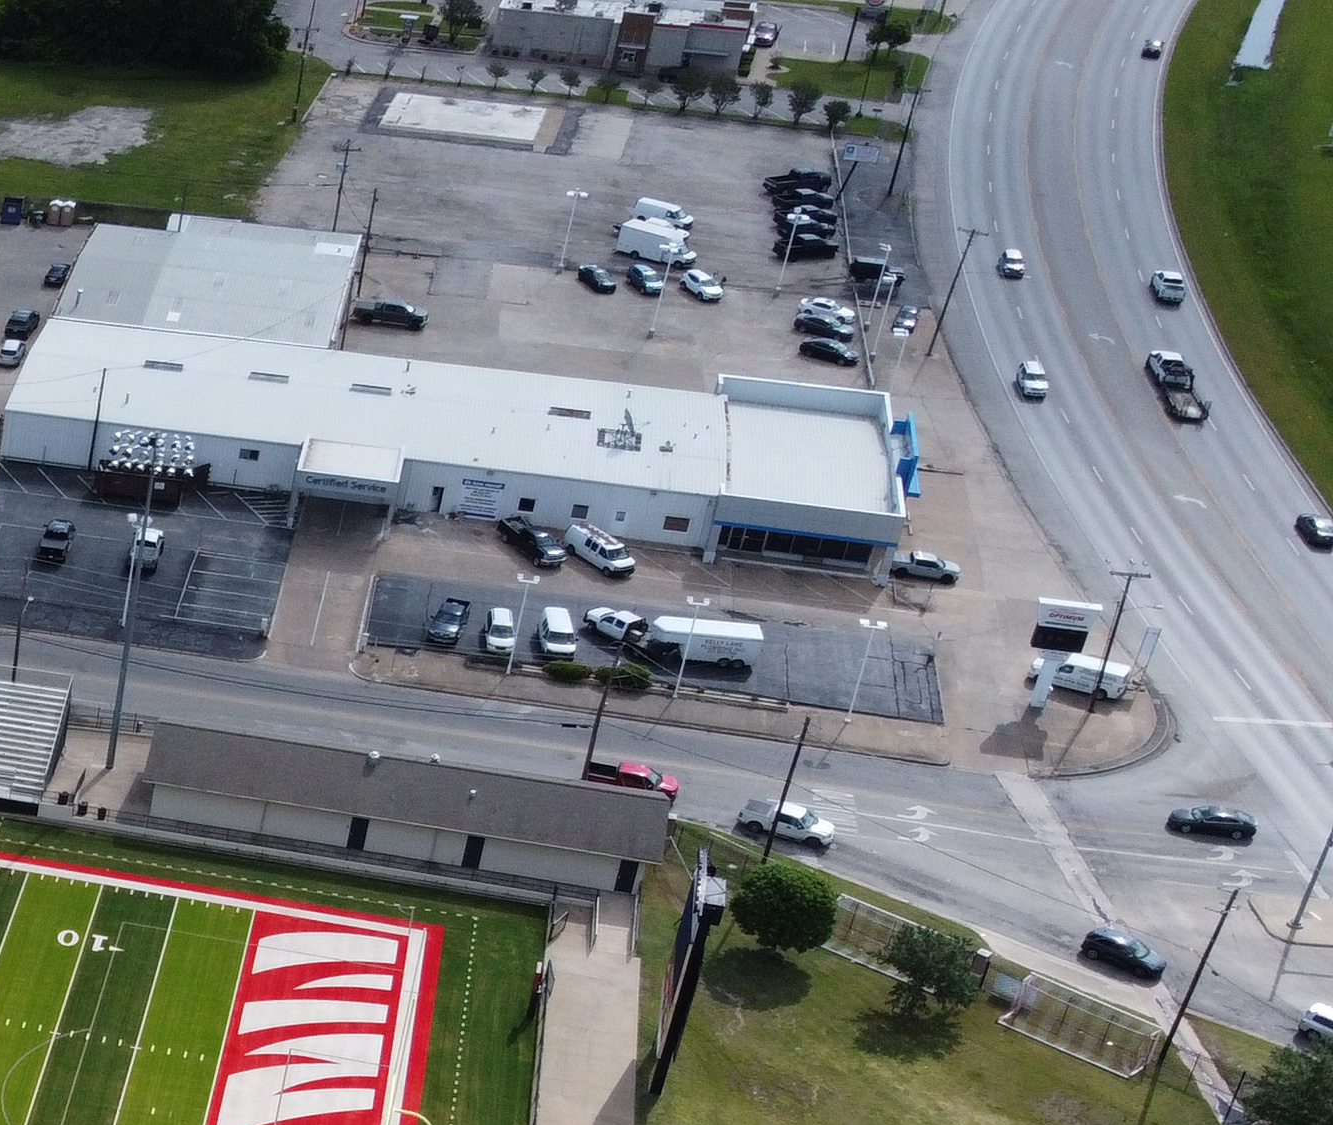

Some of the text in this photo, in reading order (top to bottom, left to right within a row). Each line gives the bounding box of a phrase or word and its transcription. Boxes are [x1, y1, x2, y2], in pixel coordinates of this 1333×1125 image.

[306, 475, 386, 493] Certified Service
[1048, 612, 1085, 622] OPTIMUM
[57, 929, 108, 952] 10
